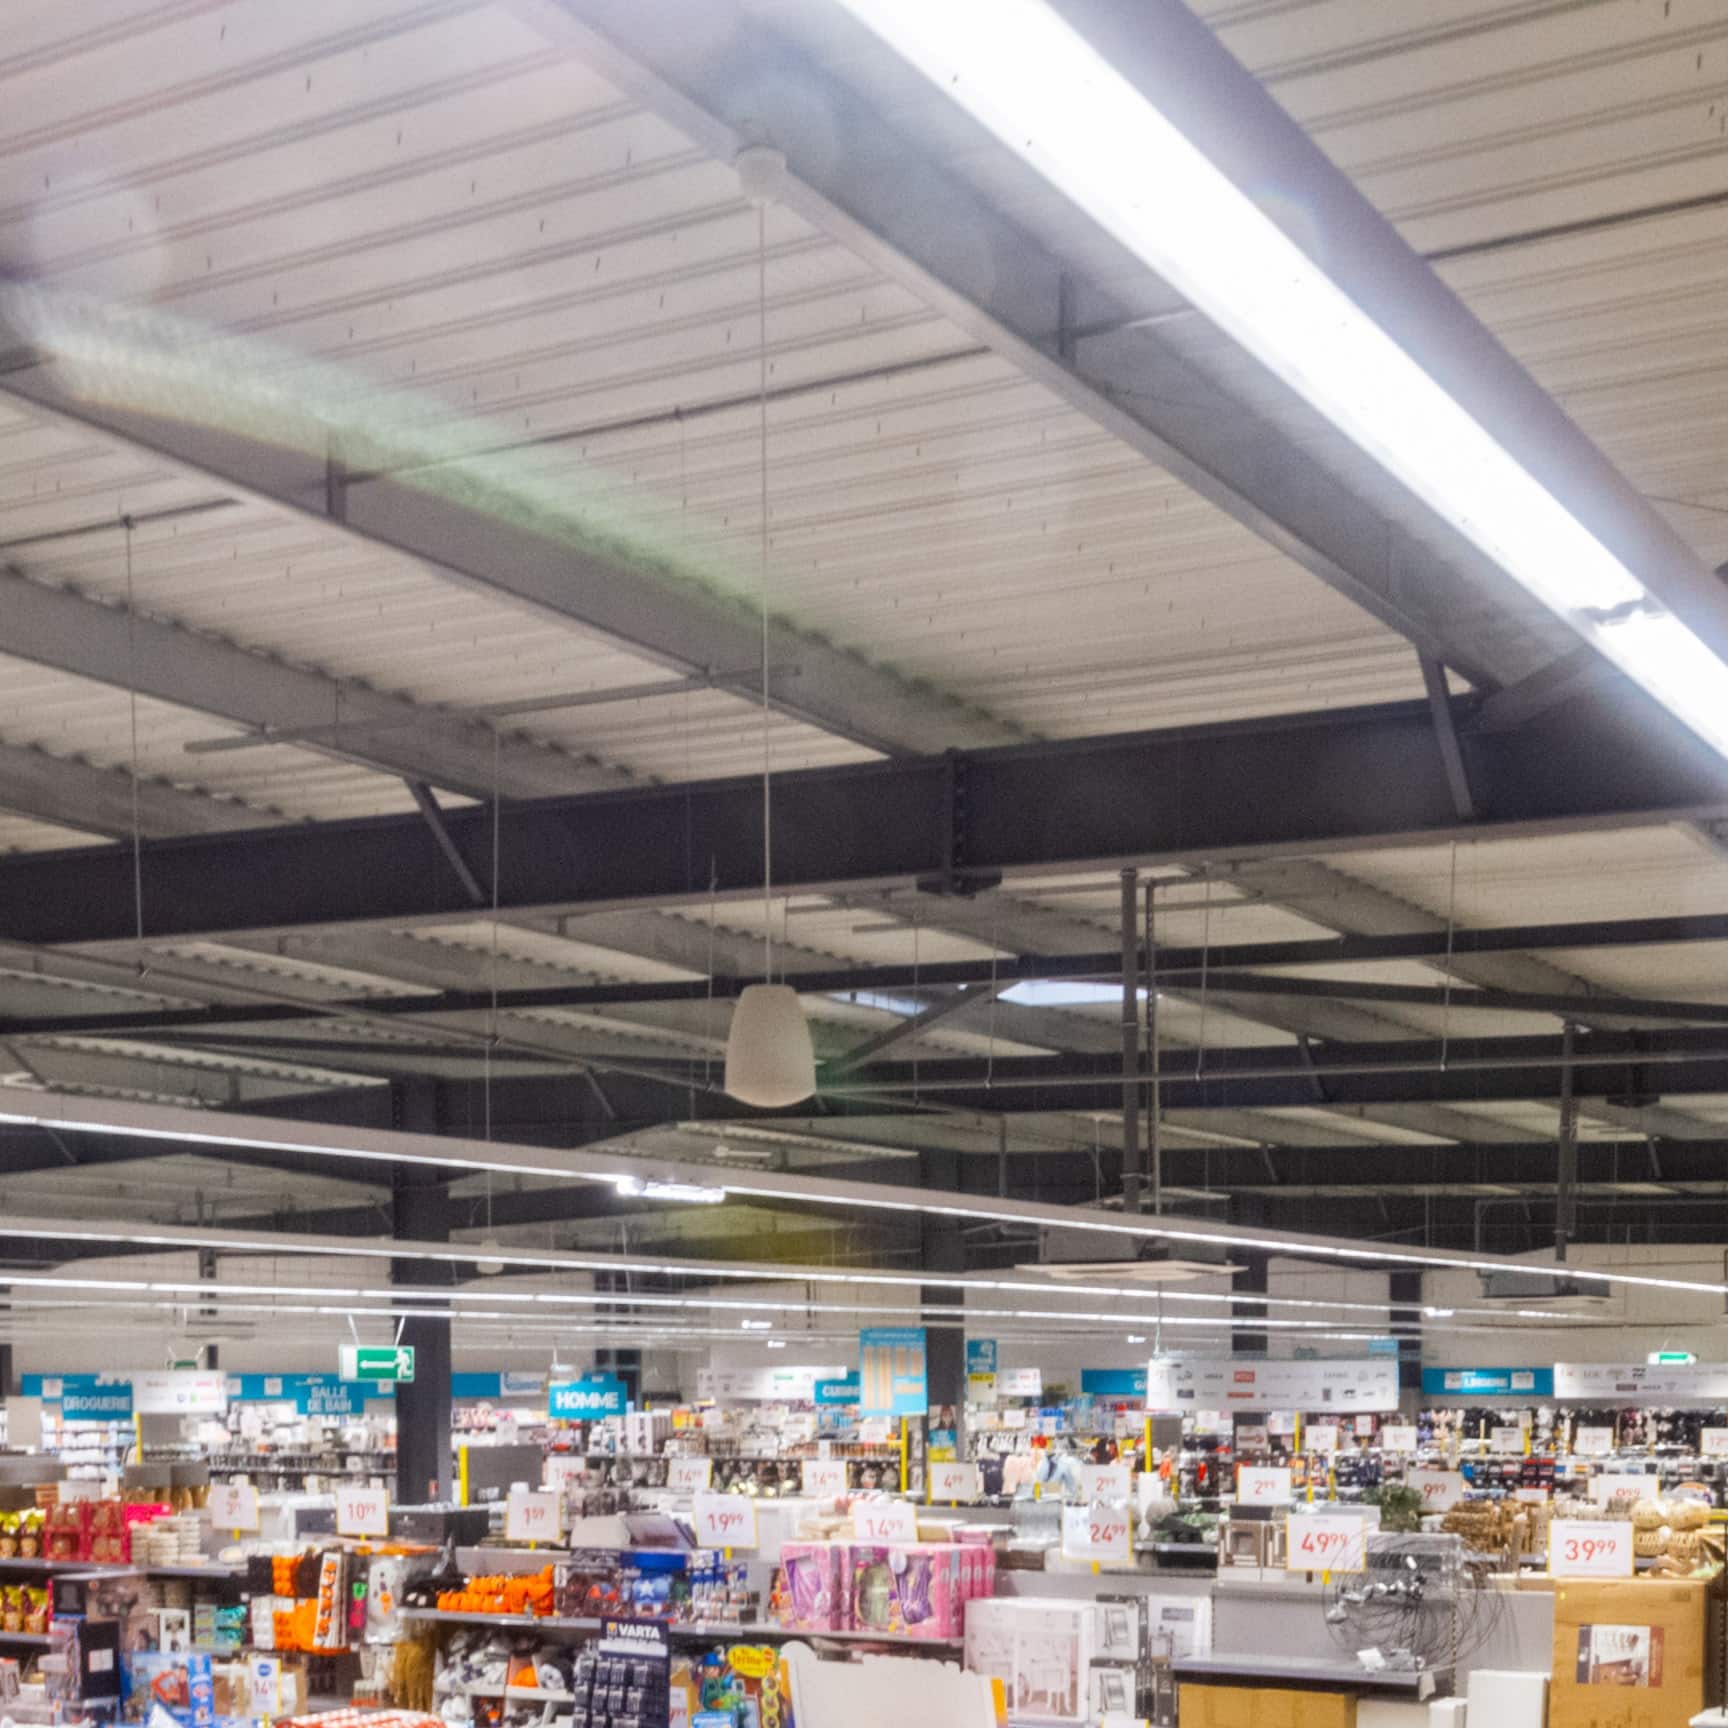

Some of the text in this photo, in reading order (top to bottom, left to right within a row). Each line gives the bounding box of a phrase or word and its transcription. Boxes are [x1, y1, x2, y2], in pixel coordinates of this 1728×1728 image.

[311, 1386, 348, 1400] SALLE
[556, 1391, 619, 1409] HOMME
[63, 1395, 131, 1412] DROGUERIE
[1301, 1532, 1350, 1553] 4999
[1565, 1538, 1617, 1562] 3999
[619, 1623, 660, 1640] VARTA
